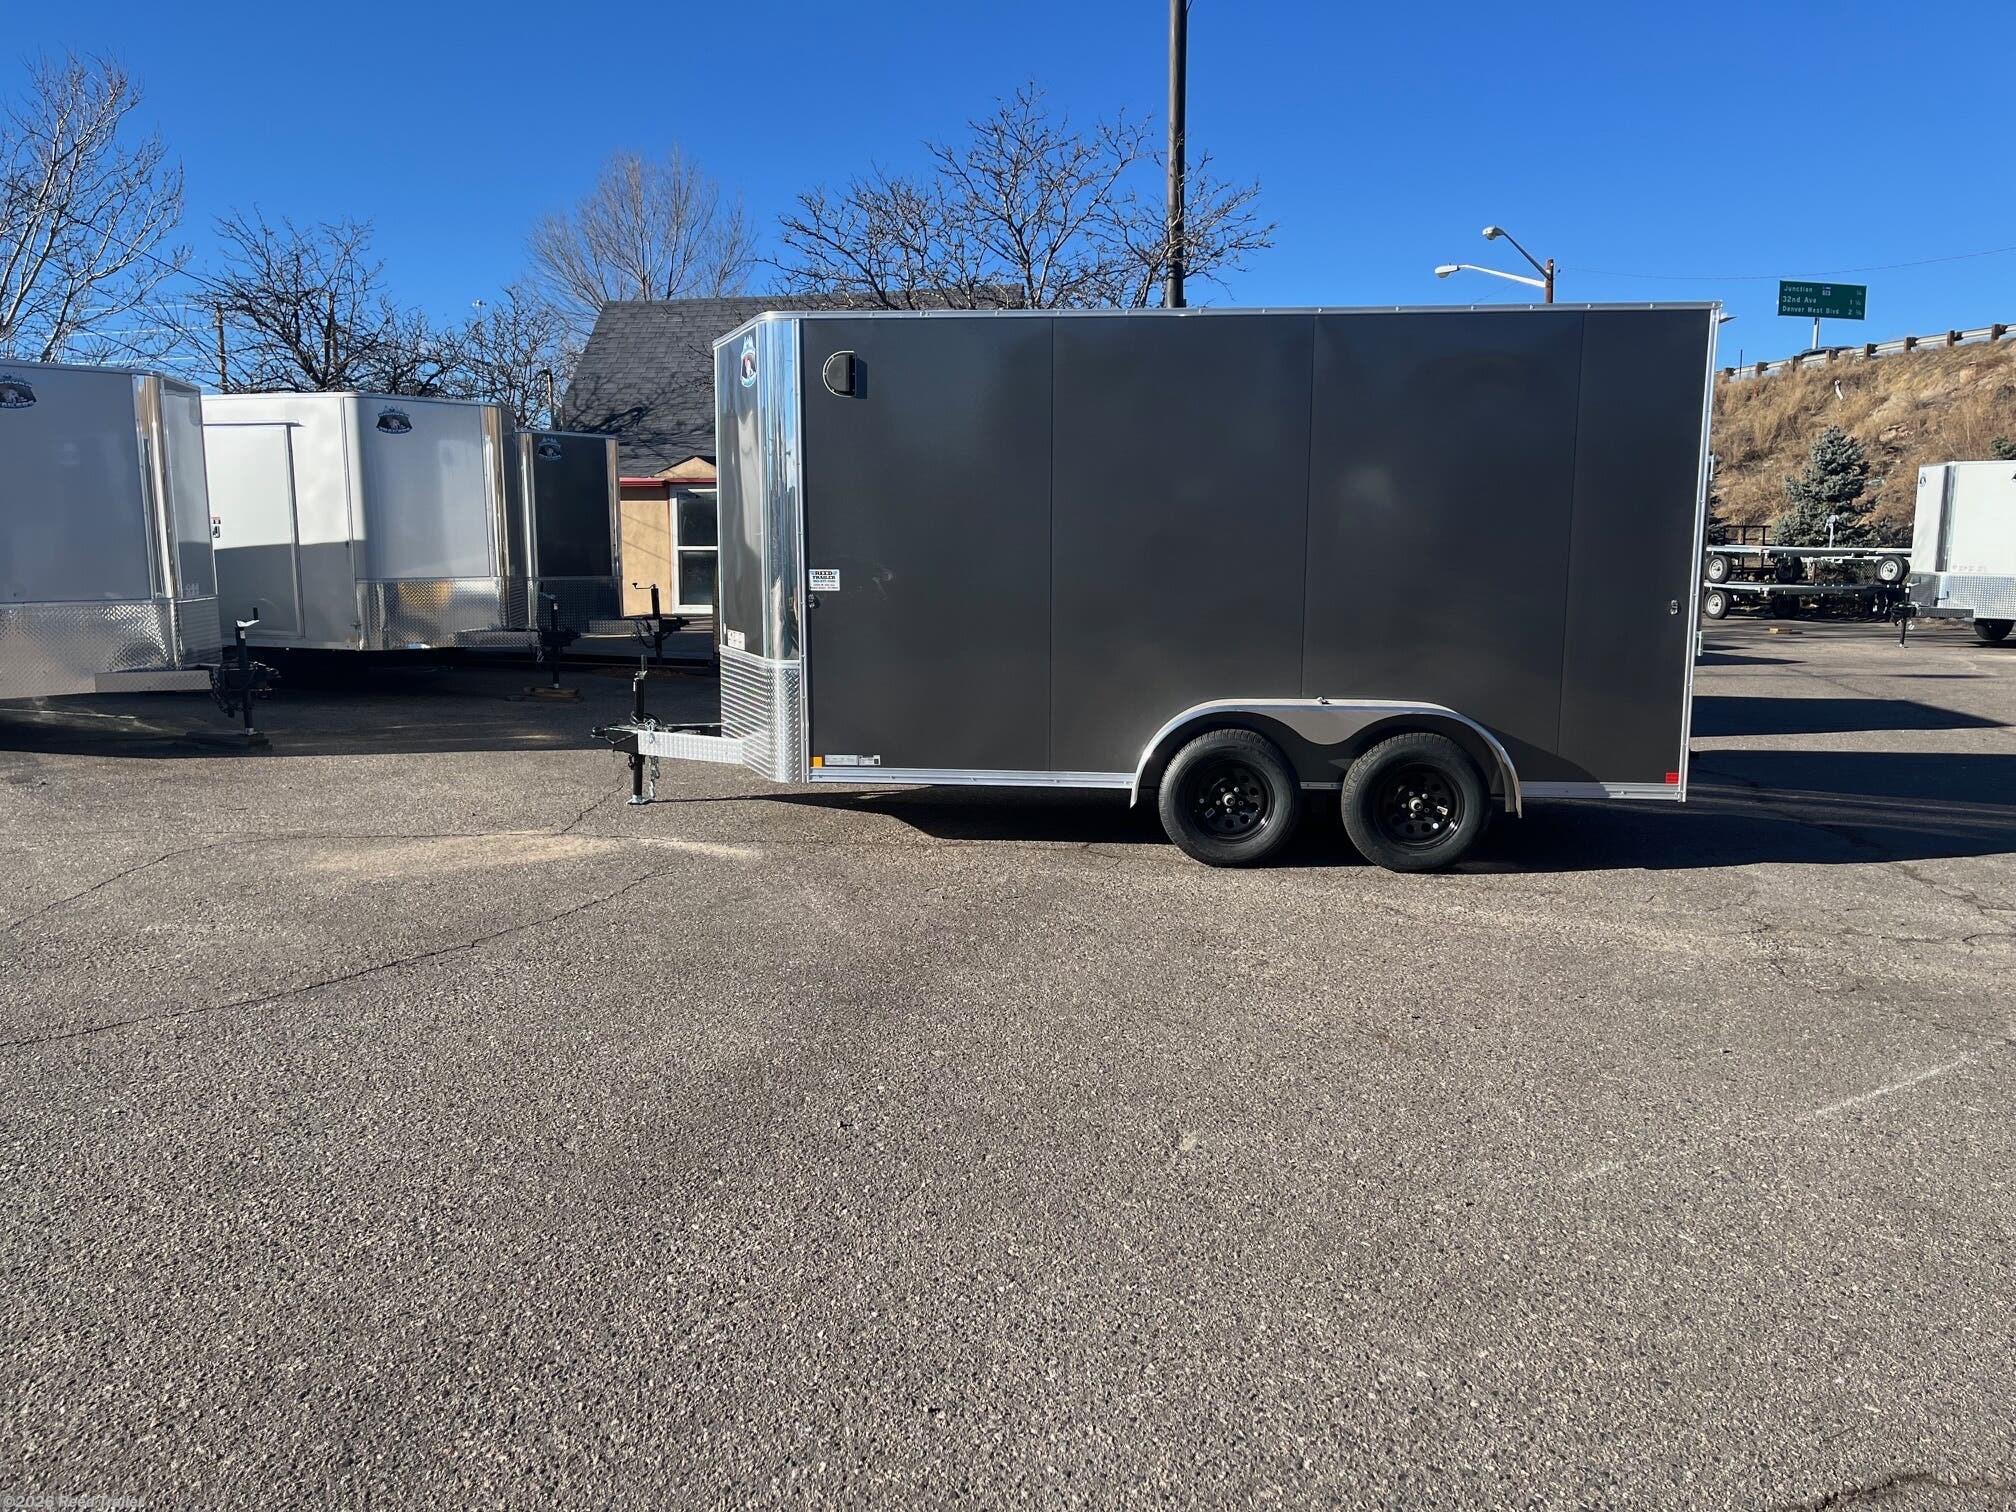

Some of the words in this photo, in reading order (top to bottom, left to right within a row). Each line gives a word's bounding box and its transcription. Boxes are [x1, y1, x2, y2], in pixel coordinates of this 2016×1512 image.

[1783, 285, 1813, 293] Junction
[1807, 306, 1823, 314] West
[1825, 307, 1840, 315] Blvd
